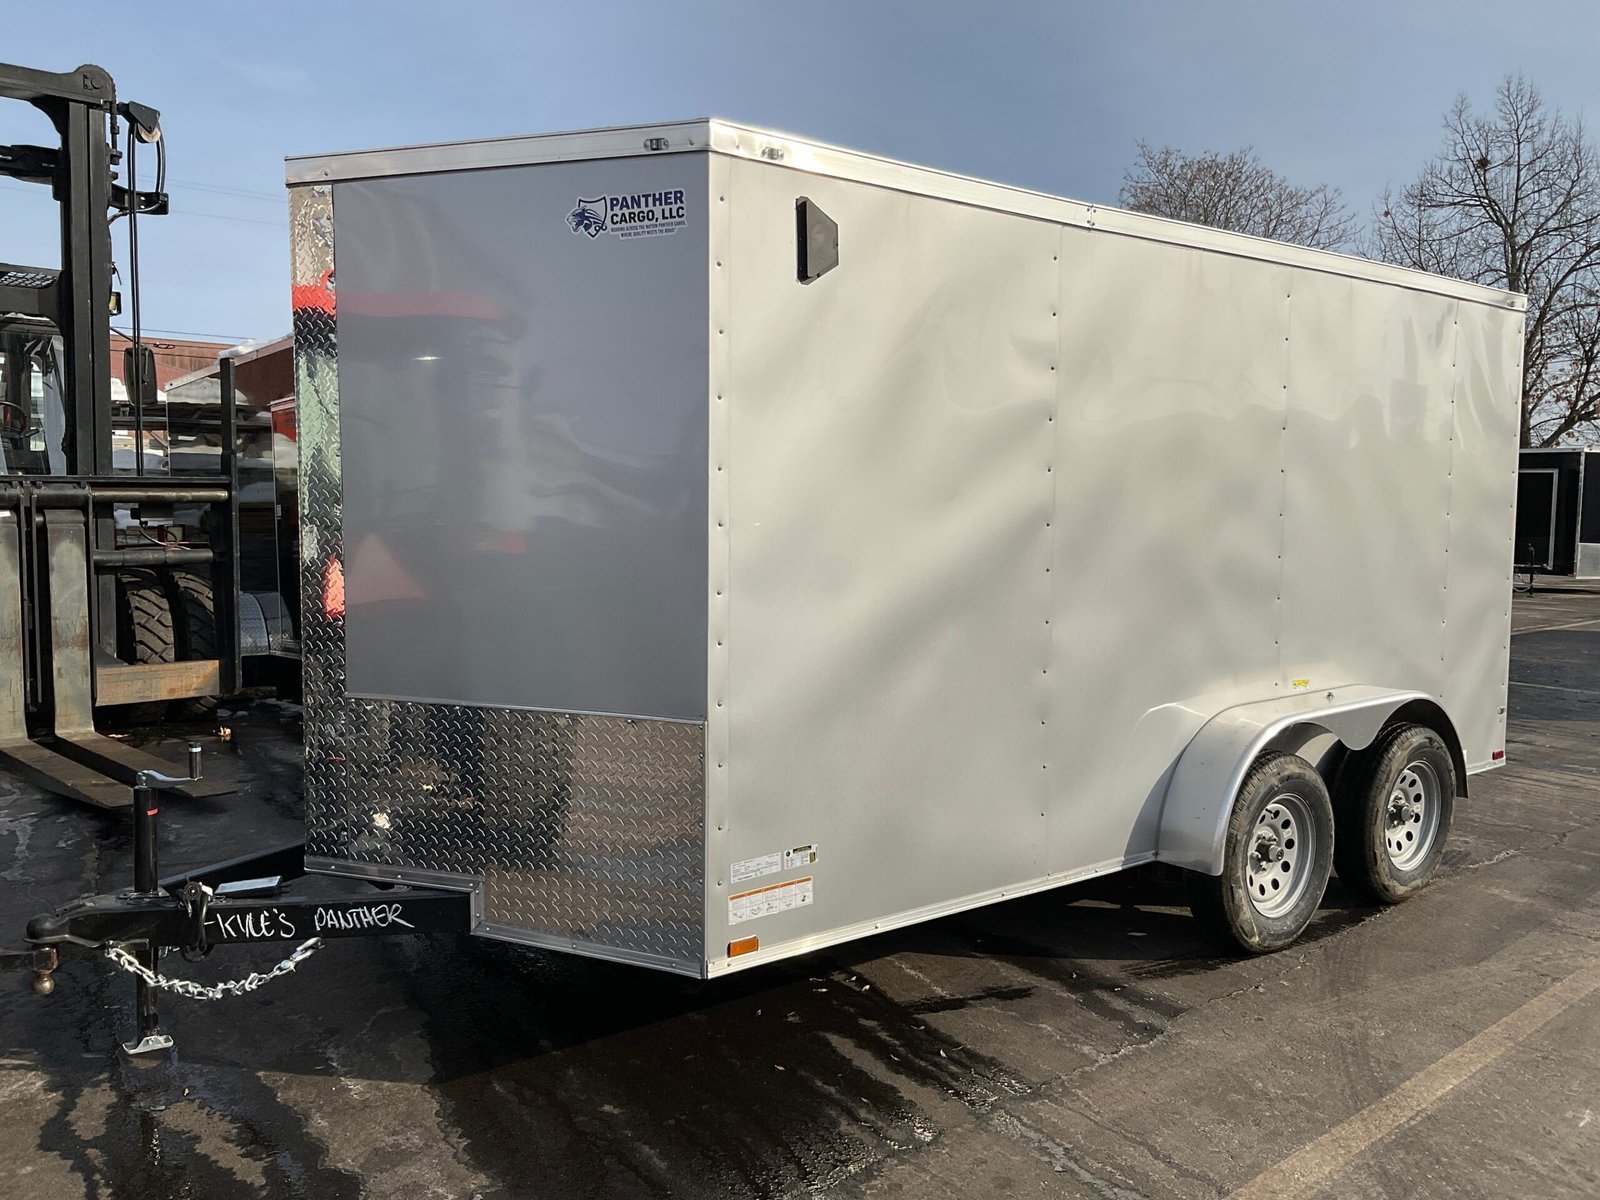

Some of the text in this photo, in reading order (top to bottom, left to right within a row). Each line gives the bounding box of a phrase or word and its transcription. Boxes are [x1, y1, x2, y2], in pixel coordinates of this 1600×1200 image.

[610, 190, 684, 211] PANTHER
[611, 206, 685, 225] CARGO, LLC
[314, 903, 415, 931] PANTHER
